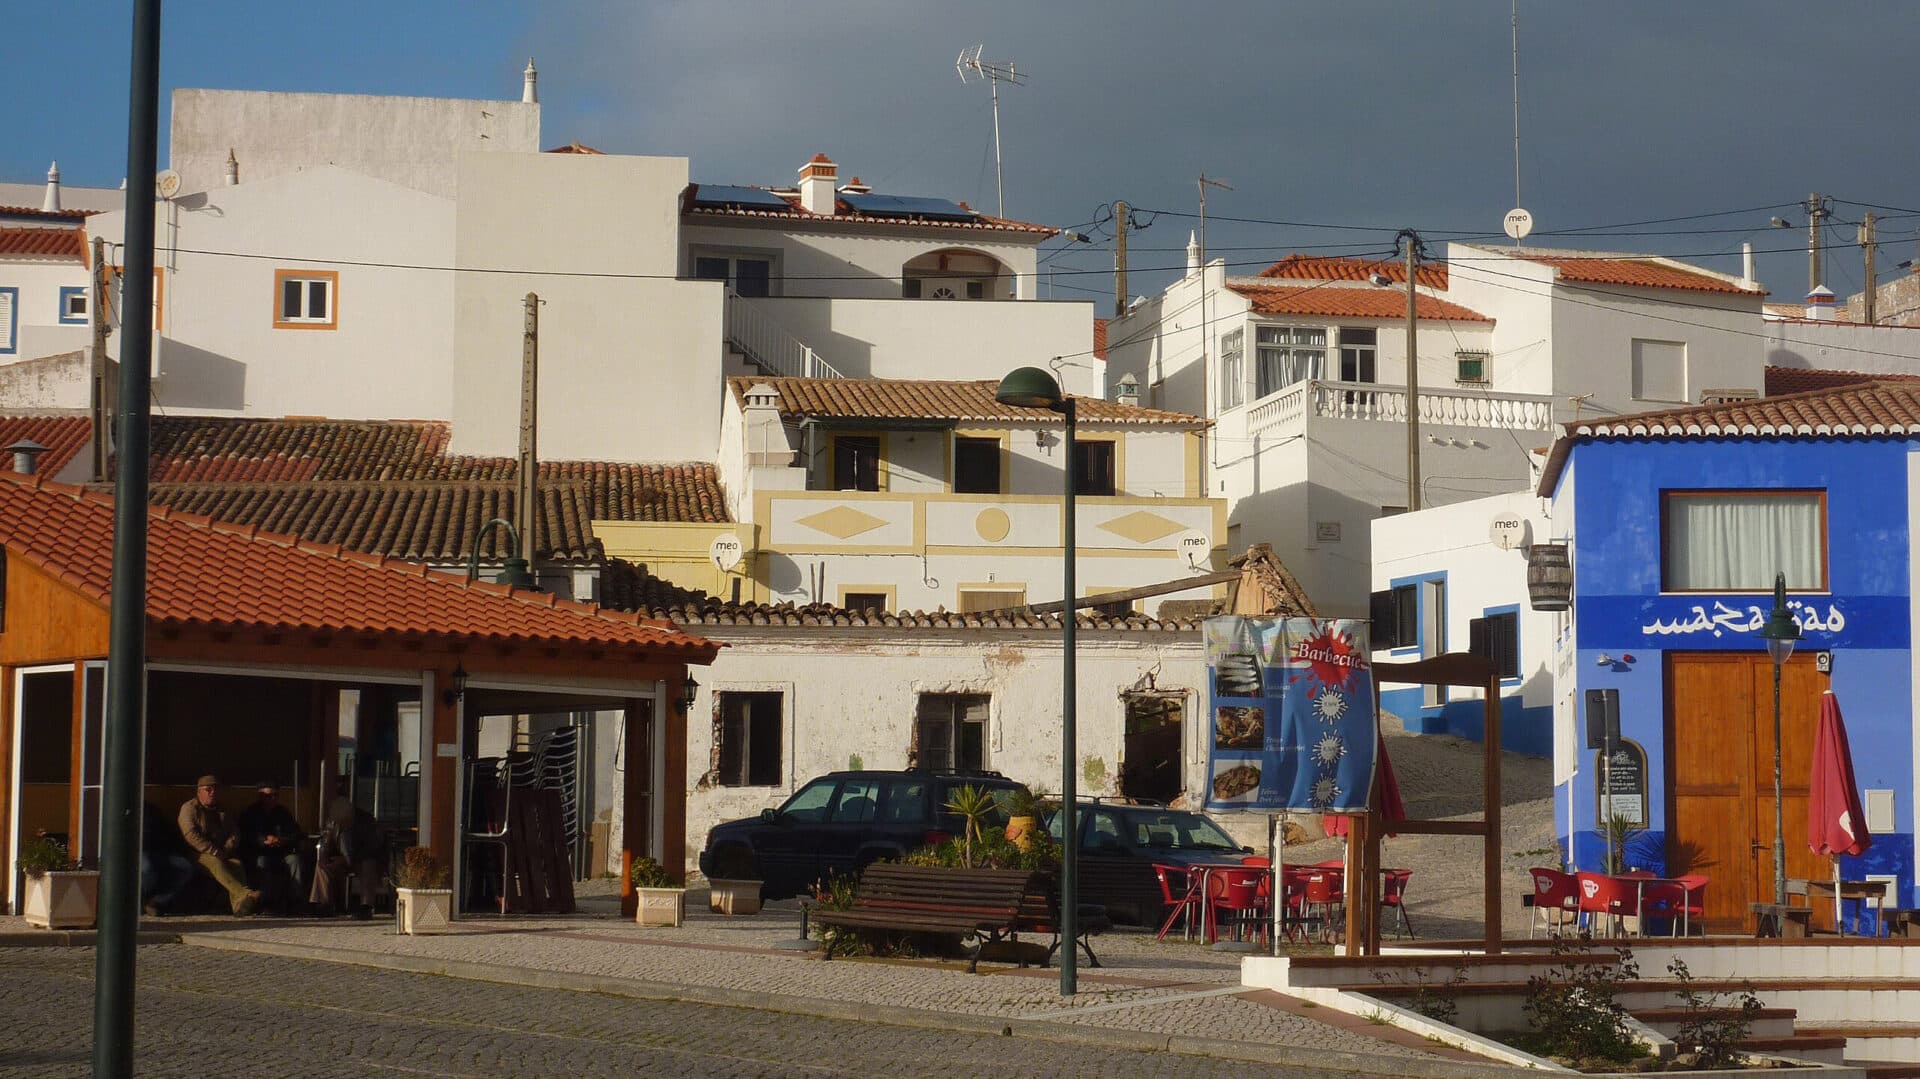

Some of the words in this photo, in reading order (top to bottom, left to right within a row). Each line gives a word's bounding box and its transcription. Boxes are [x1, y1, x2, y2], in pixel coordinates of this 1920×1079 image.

[1494, 520, 1519, 529] meo
[716, 542, 738, 550] meo
[1184, 537, 1206, 546] meo
[1298, 643, 1361, 668] Barbecue
